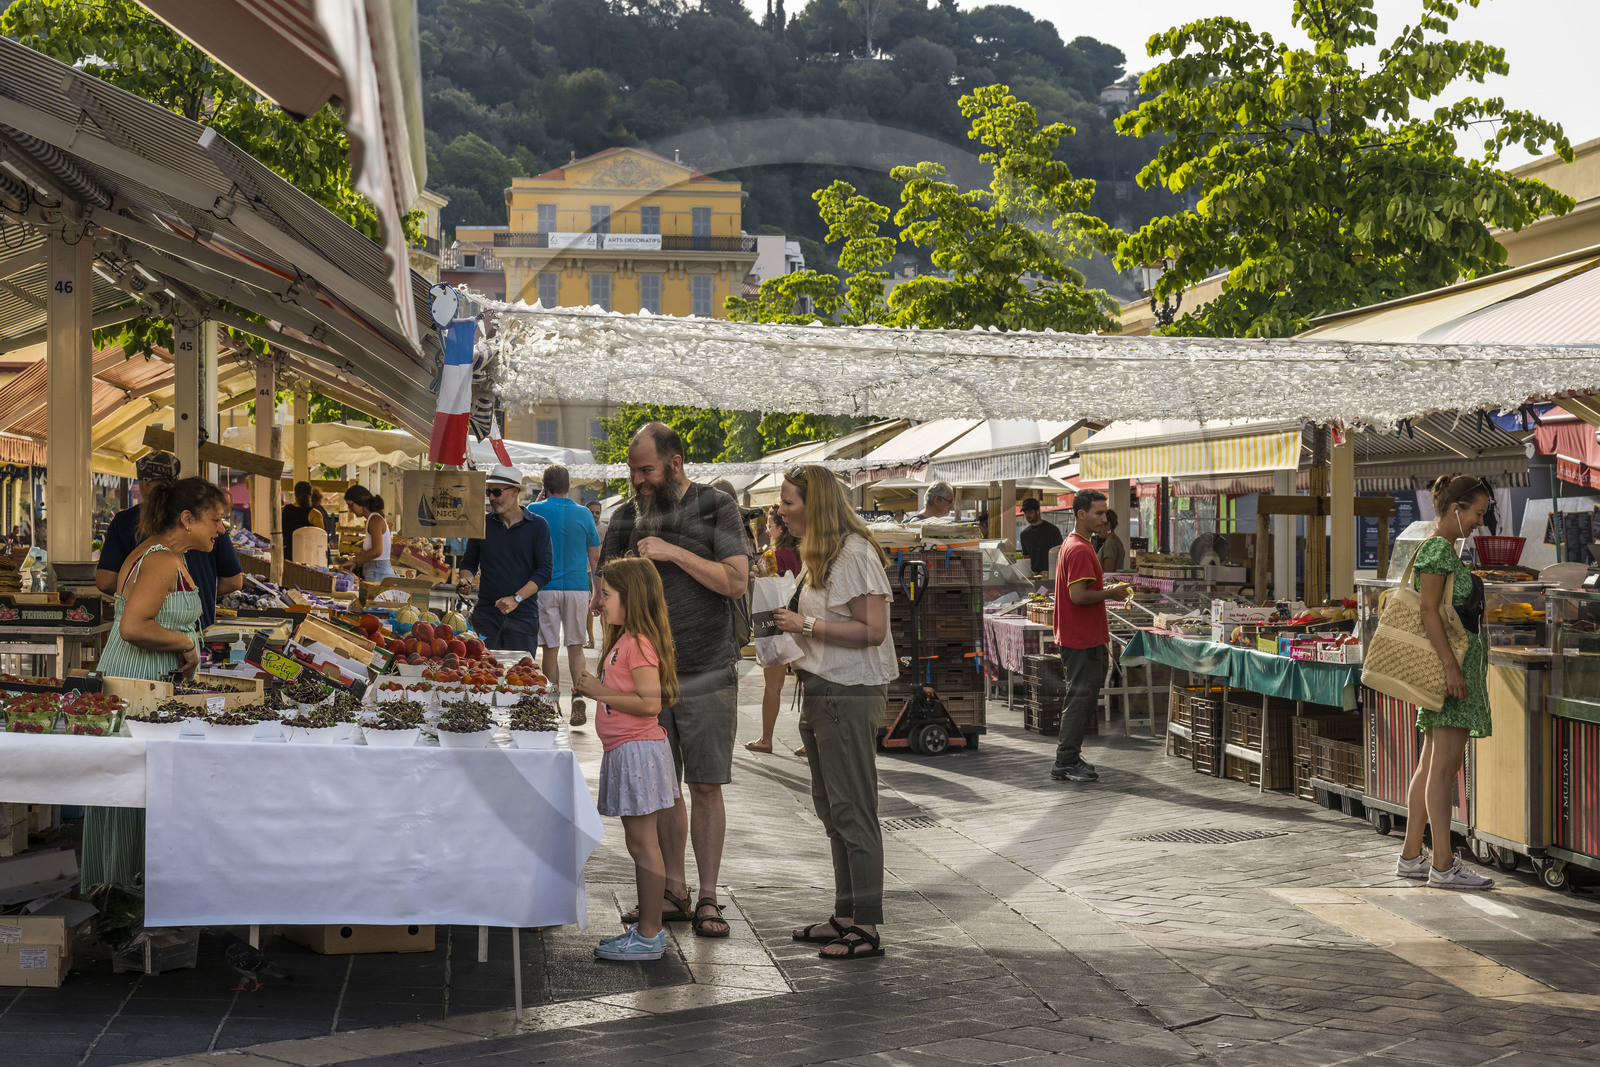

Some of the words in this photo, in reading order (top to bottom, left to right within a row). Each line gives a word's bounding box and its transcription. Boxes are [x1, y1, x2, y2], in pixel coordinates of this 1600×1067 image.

[54, 280, 73, 294] 46
[179, 341, 193, 351] 45
[436, 510, 457, 518] NICE
[261, 652, 295, 680] Prestige
[1563, 811, 1569, 820] J.
